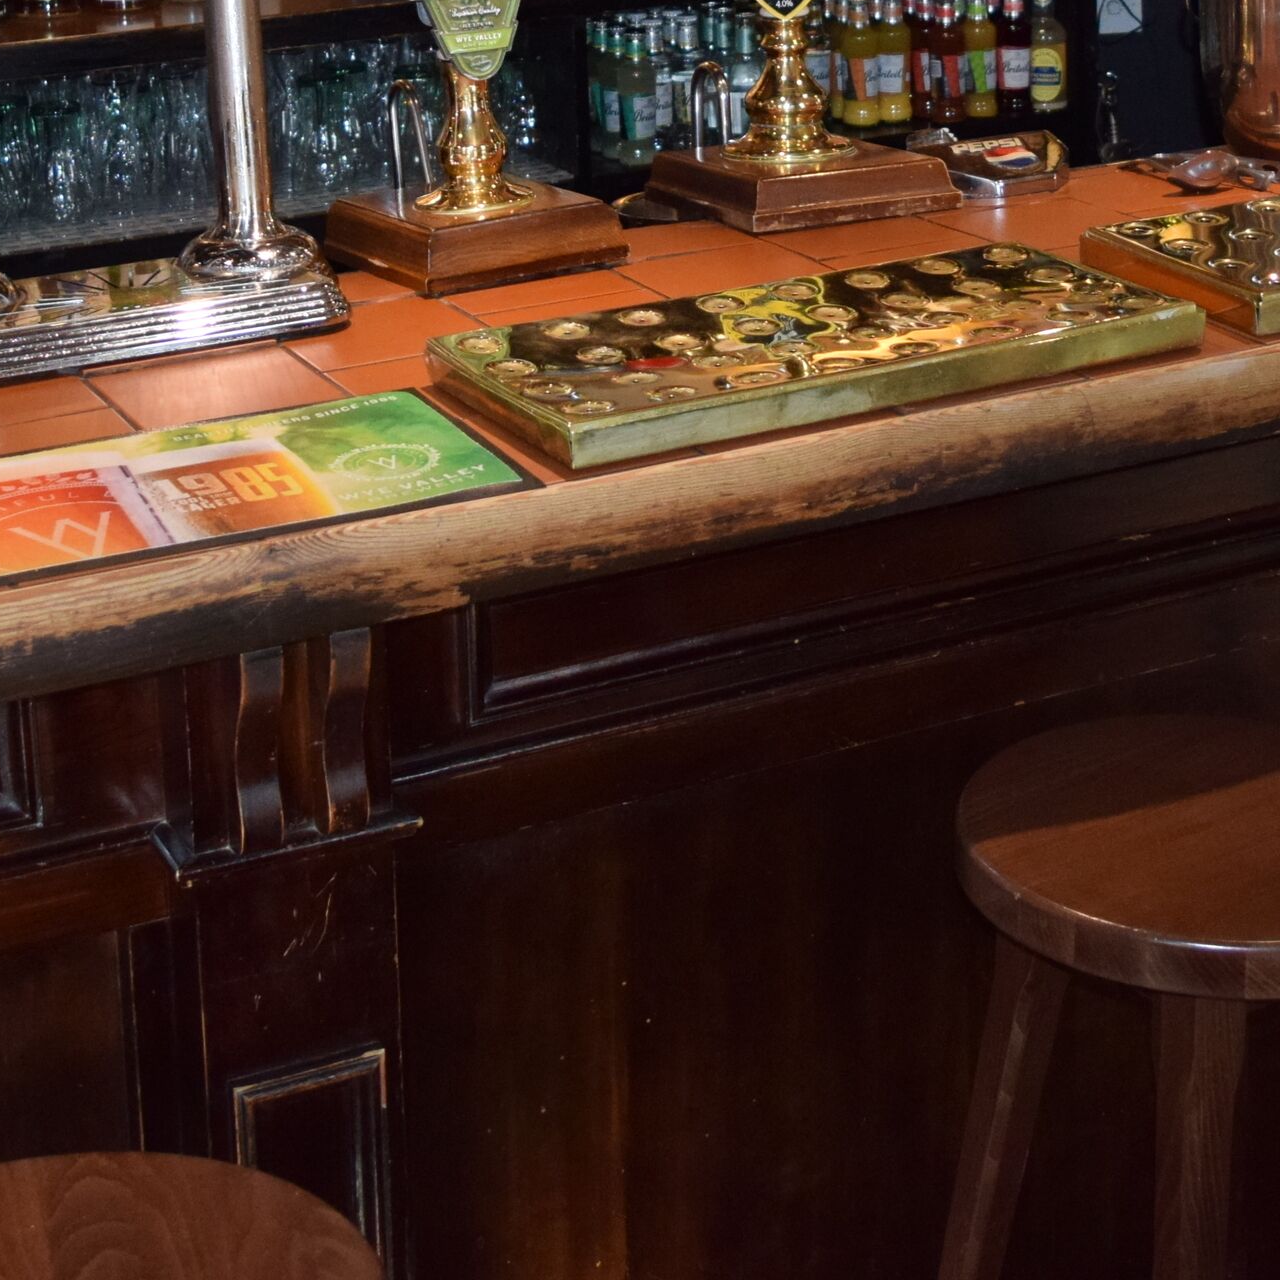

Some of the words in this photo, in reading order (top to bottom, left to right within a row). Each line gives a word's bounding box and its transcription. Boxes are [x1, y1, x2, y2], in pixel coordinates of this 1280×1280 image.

[775, 0, 794, 9] 4.0%
[455, 35, 471, 45] WYE
[472, 32, 503, 42] VALLEY
[950, 136, 1023, 156] PEPSI
[313, 404, 360, 420] SINCE
[154, 461, 306, 507] 1985
[337, 484, 392, 505] WYE
[403, 462, 487, 491] VALLEY
